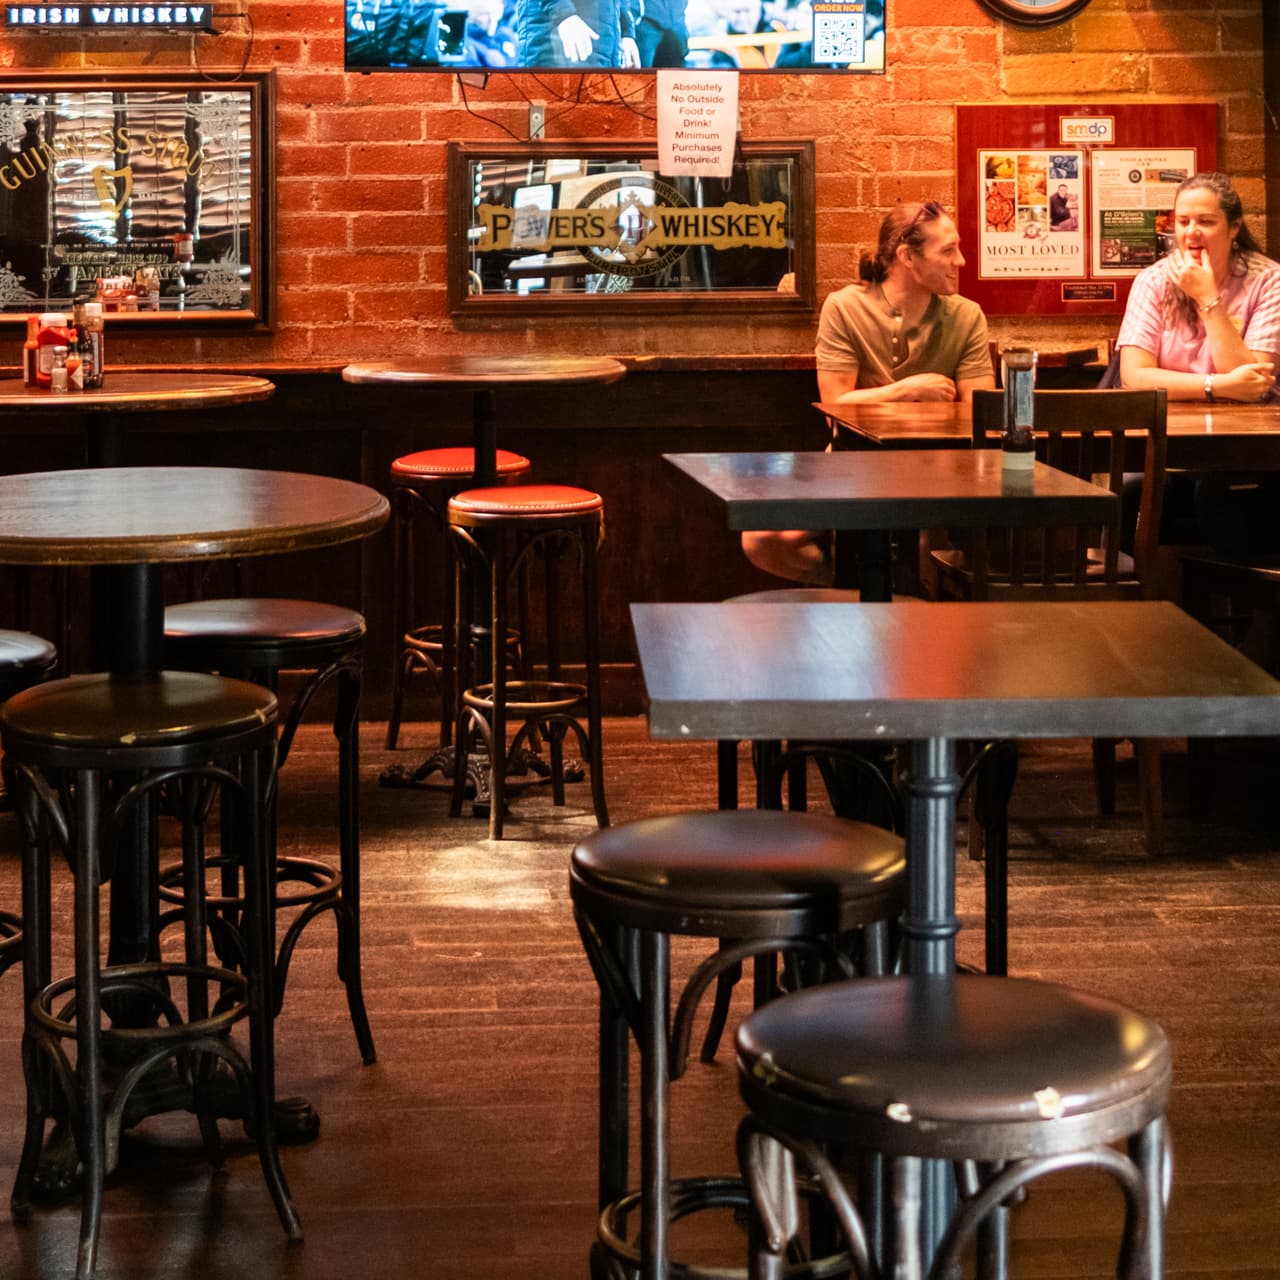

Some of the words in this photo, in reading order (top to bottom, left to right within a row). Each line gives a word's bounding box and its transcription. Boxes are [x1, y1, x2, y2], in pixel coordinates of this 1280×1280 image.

[814, 3, 842, 12] ORDER
[842, 3, 865, 12] NOW
[9, 6, 80, 24] IRISH
[91, 6, 205, 24] WHISKEY
[672, 82, 723, 93] Absolutely
[671, 95, 684, 103] No
[687, 94, 725, 104] Outside
[679, 107, 703, 115] Food
[706, 108, 716, 116] or
[683, 119, 712, 127] Drink!
[1066, 122, 1108, 137] smdp
[674, 131, 720, 139] Minimum
[672, 143, 723, 152] Purchases
[674, 155, 720, 166] Required!
[661, 214, 777, 238] WHISKEY
[986, 245, 1028, 256] MOST
[1031, 244, 1080, 256] LOVED
